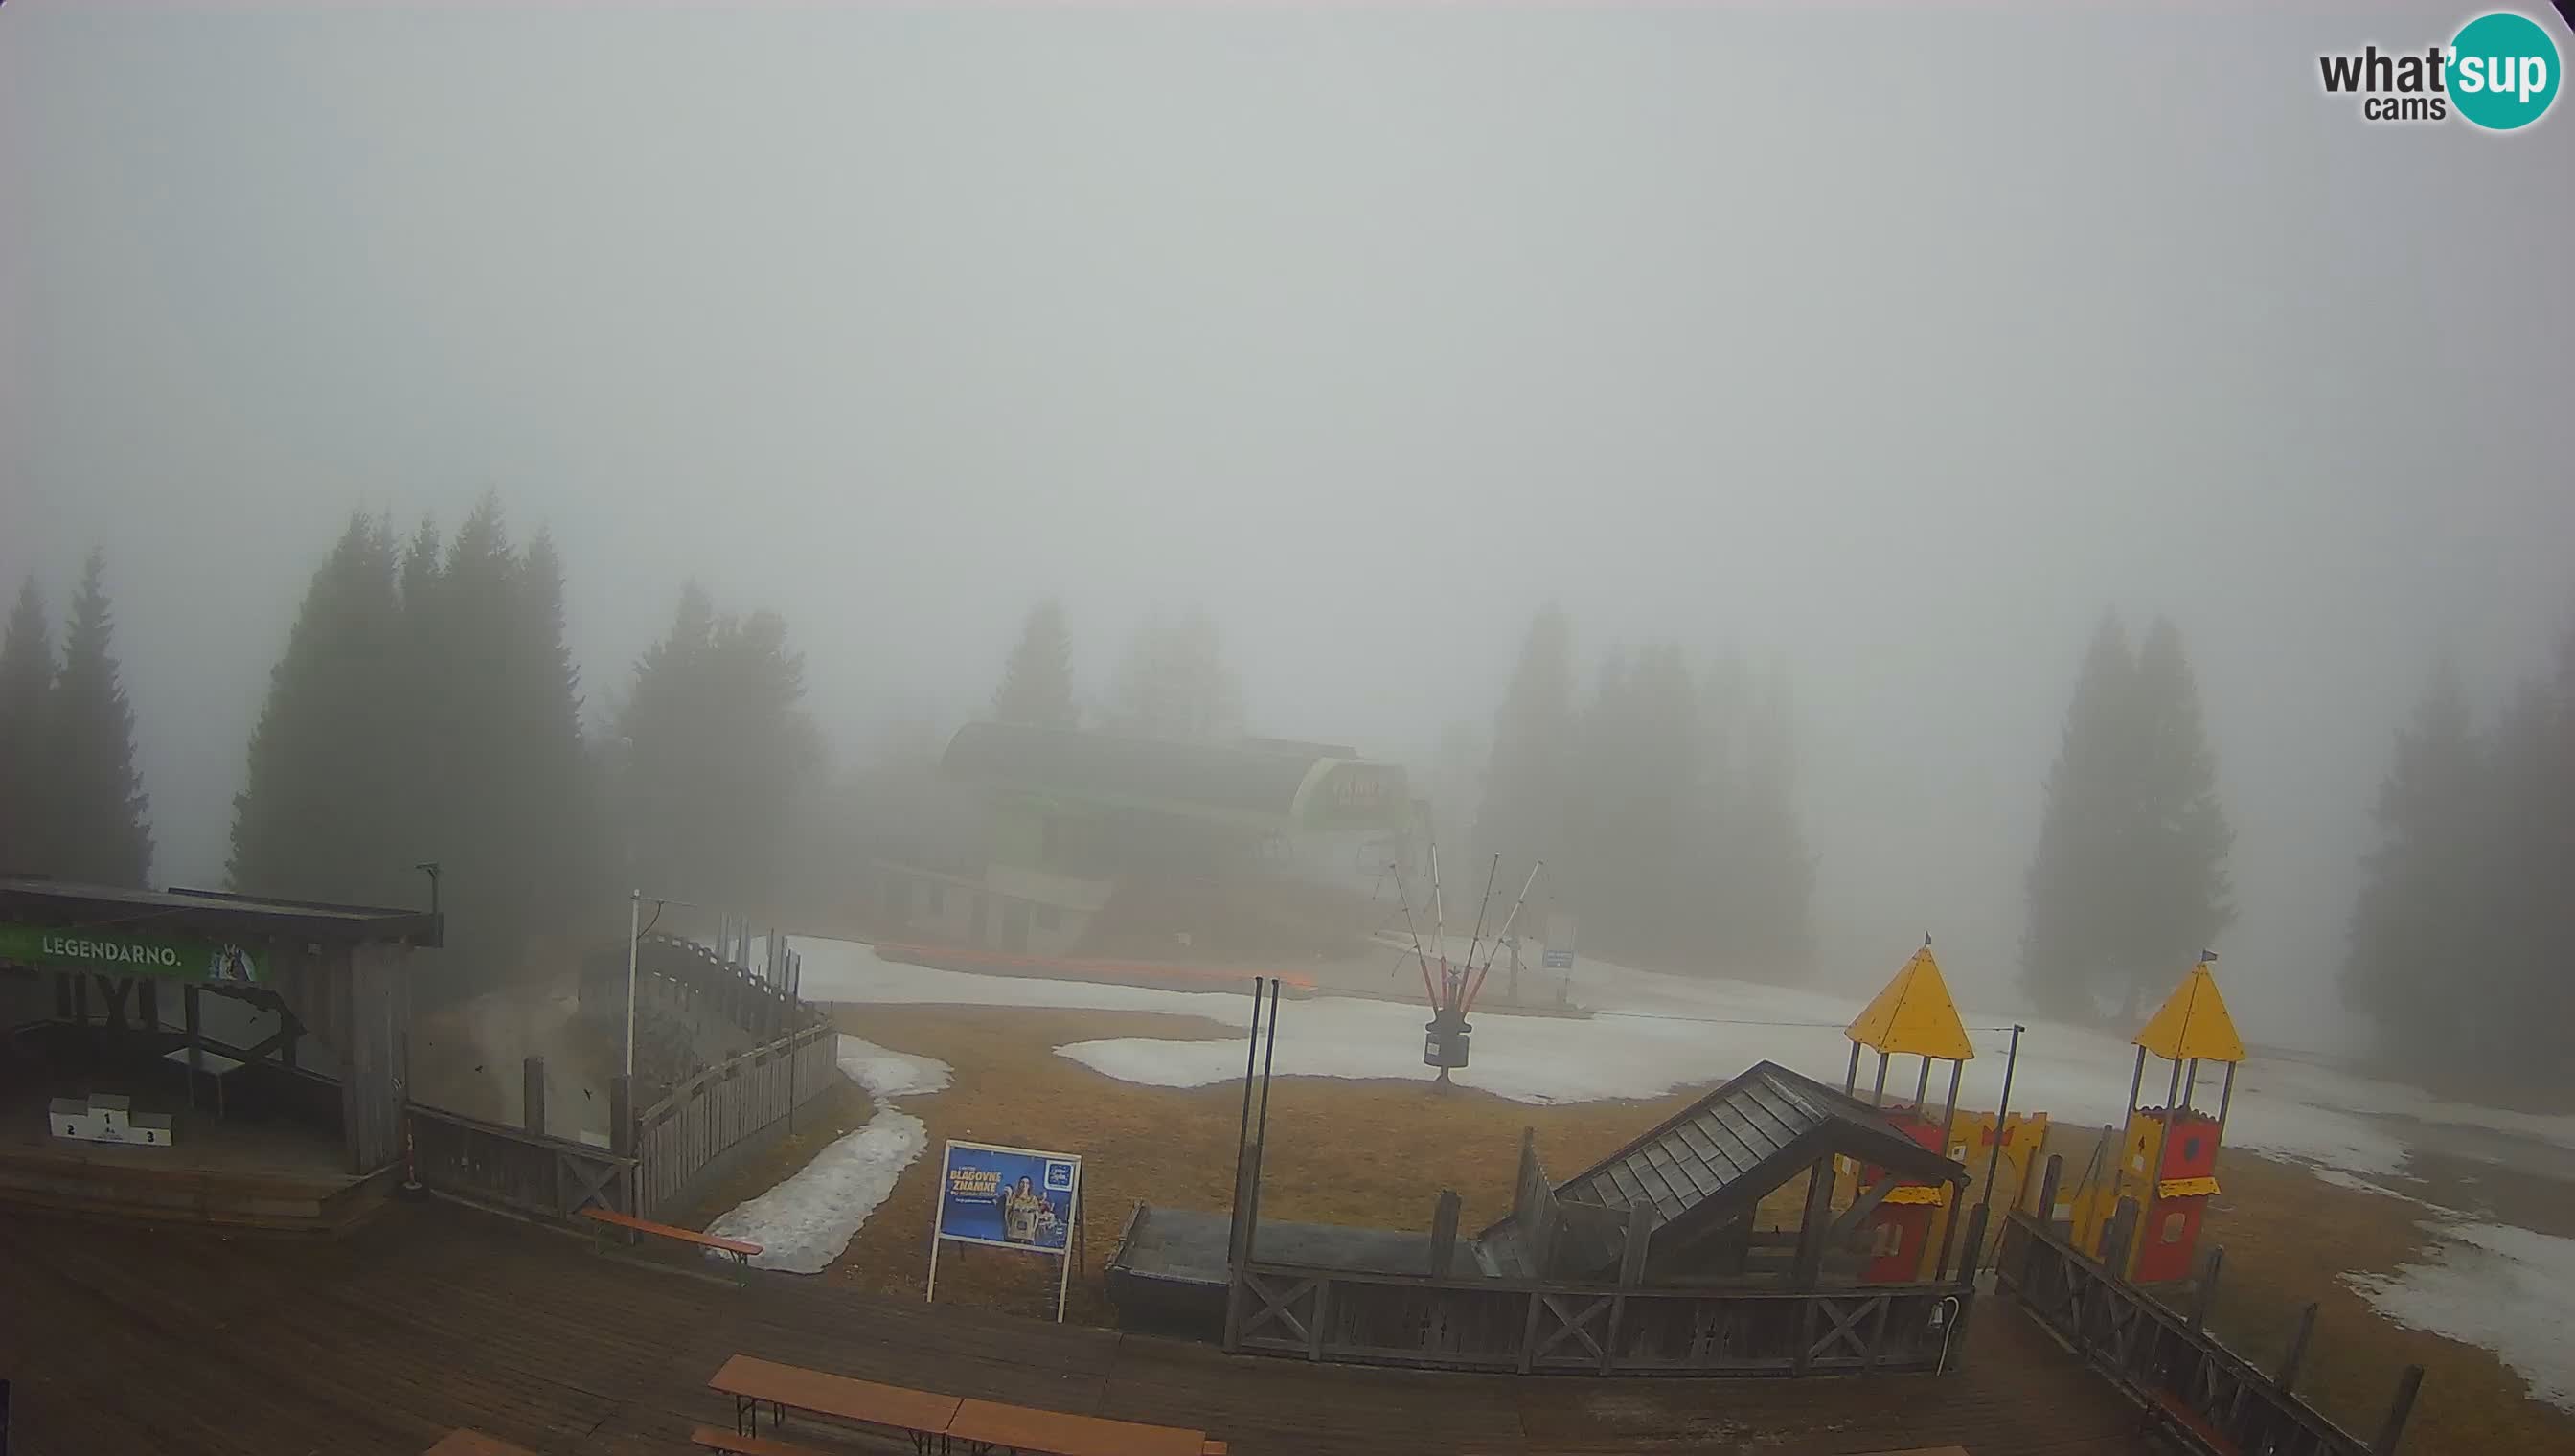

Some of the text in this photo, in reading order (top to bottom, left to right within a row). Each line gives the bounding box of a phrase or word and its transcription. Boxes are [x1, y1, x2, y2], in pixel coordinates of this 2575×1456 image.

[42, 935, 182, 967] LEGENDARNO.
[104, 1113, 111, 1125] 1
[67, 1125, 75, 1135] 2
[147, 1131, 155, 1143] 3
[950, 1170, 1002, 1183] BLAGOVNE
[952, 1180, 997, 1192] ZNAMKE
